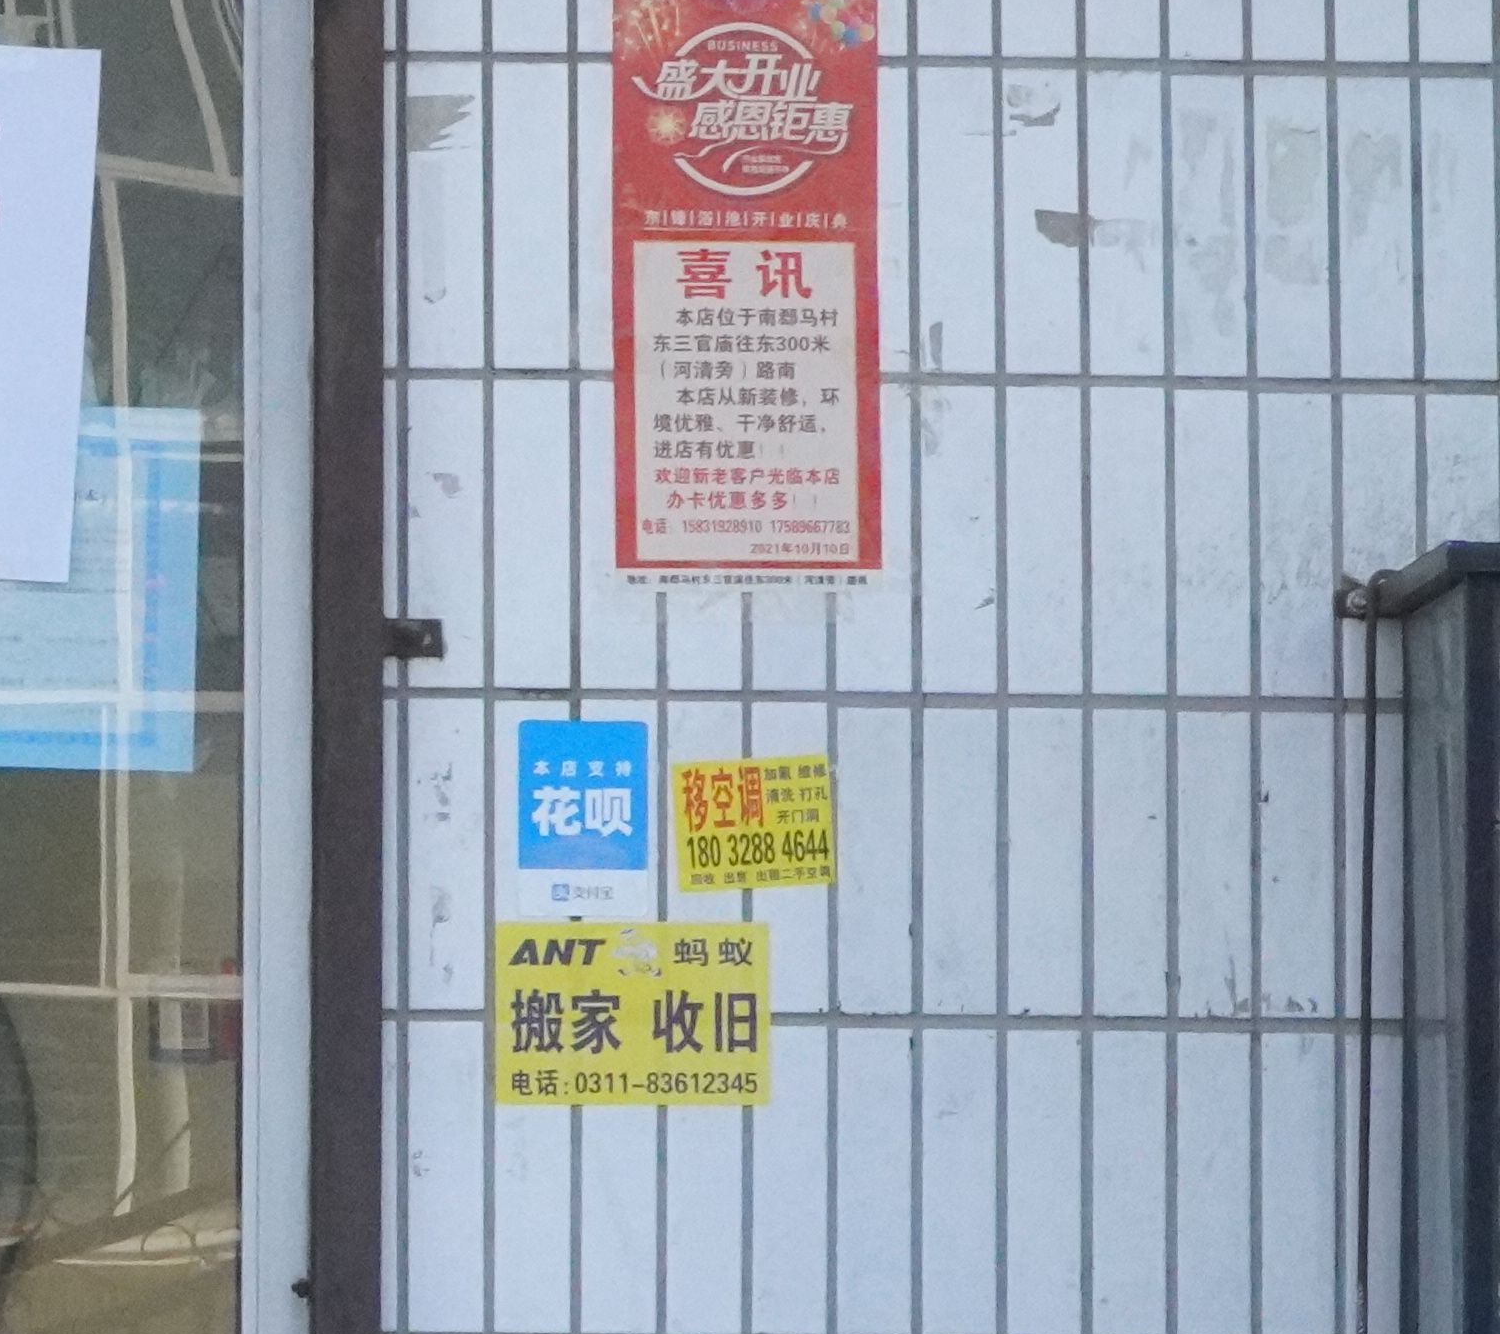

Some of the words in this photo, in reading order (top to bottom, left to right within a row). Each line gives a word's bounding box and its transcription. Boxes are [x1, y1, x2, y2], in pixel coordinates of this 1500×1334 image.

[707, 39, 779, 52] BUSINESS
[650, 53, 822, 102] 盛大开业
[676, 248, 813, 299] 喜讯
[653, 335, 831, 354] 东三官庙往东300米
[655, 468, 841, 485] 欢迎新老客户光临本店
[750, 543, 850, 557] 2021年10月10日
[532, 760, 632, 778] 本店支持
[682, 765, 765, 834] 移空调
[766, 787, 795, 805] 清洗
[799, 785, 828, 803] 打孔
[532, 785, 633, 838] 花呗
[686, 834, 722, 869] 180
[726, 832, 776, 867] 3288
[782, 829, 830, 862] 4644
[573, 885, 615, 900] 支付宝
[508, 938, 607, 966] ANT
[673, 936, 753, 967] 蚂蚁
[511, 988, 622, 1055] 搬家
[652, 988, 758, 1054] 收旧
